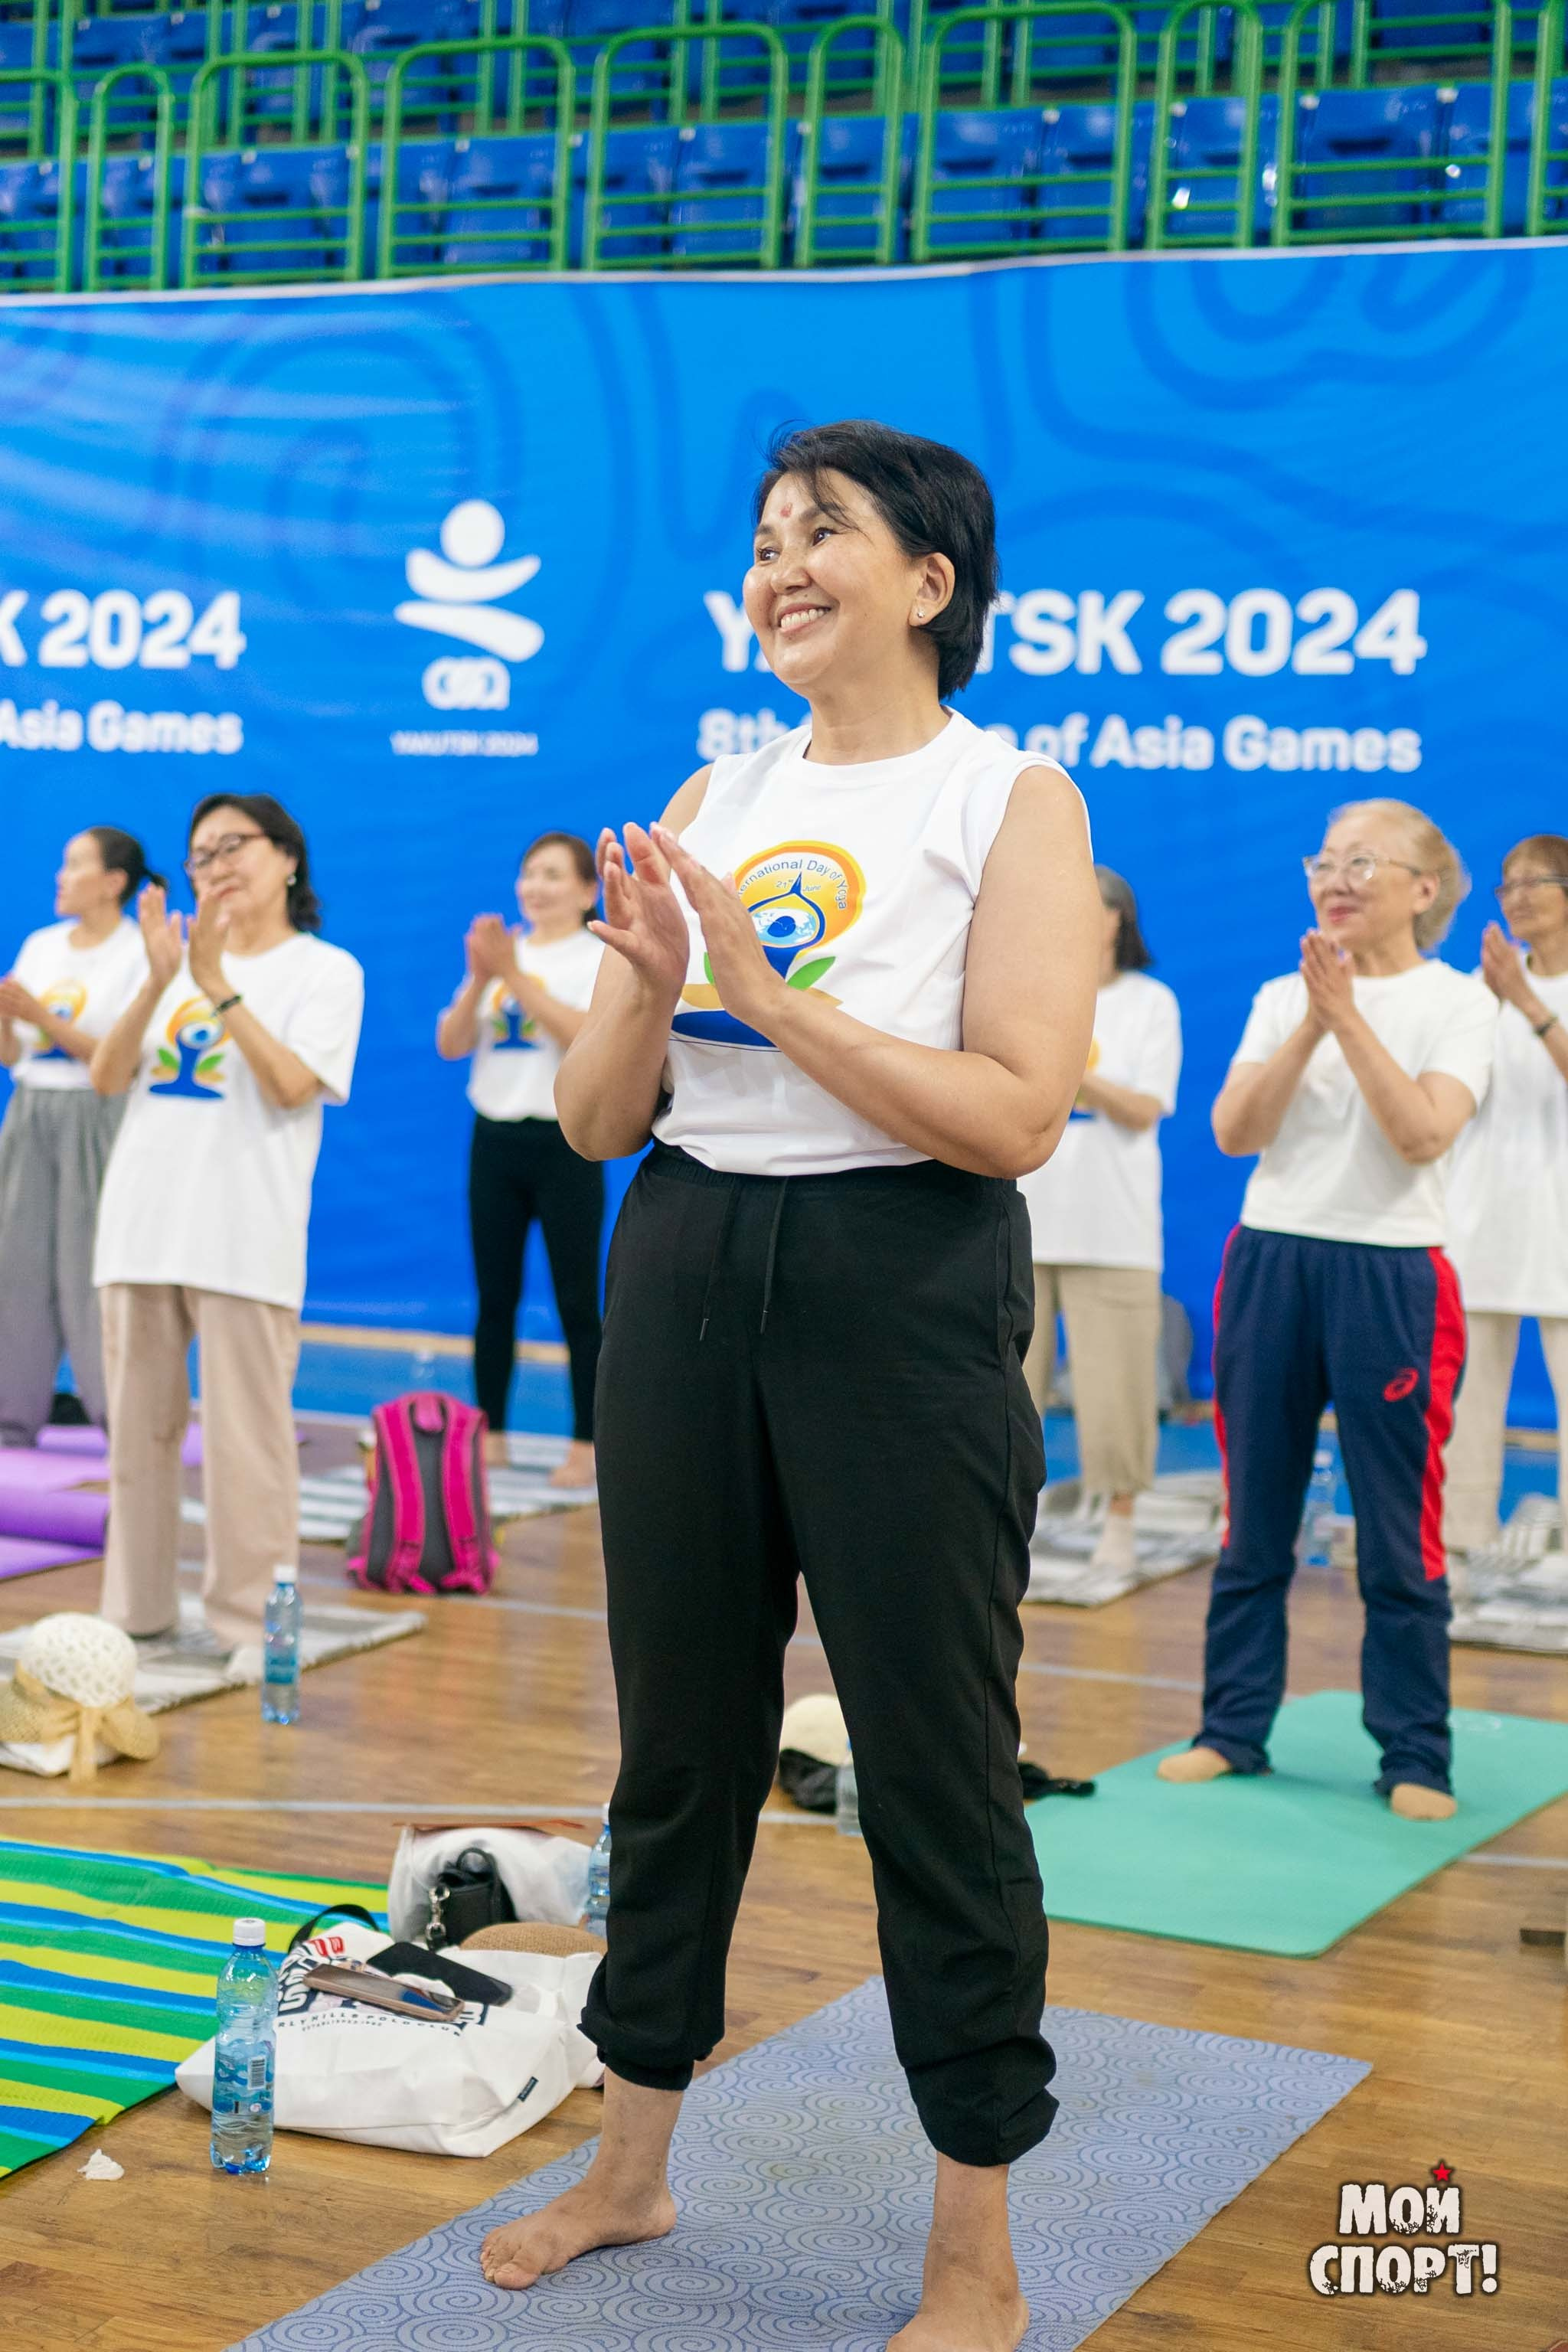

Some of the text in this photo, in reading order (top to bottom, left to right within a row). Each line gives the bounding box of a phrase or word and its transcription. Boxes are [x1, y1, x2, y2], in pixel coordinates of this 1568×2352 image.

[38, 589, 247, 669] 2024
[703, 586, 1428, 677] YTSK 2024
[87, 699, 244, 755] Games
[697, 707, 791, 762] 8th
[1024, 712, 1089, 768] of
[1090, 713, 1215, 769] Asia
[1223, 714, 1423, 773] Games
[738, 859, 848, 910] ternational Day of Yoga
[367, 2014, 410, 2026] POLO
